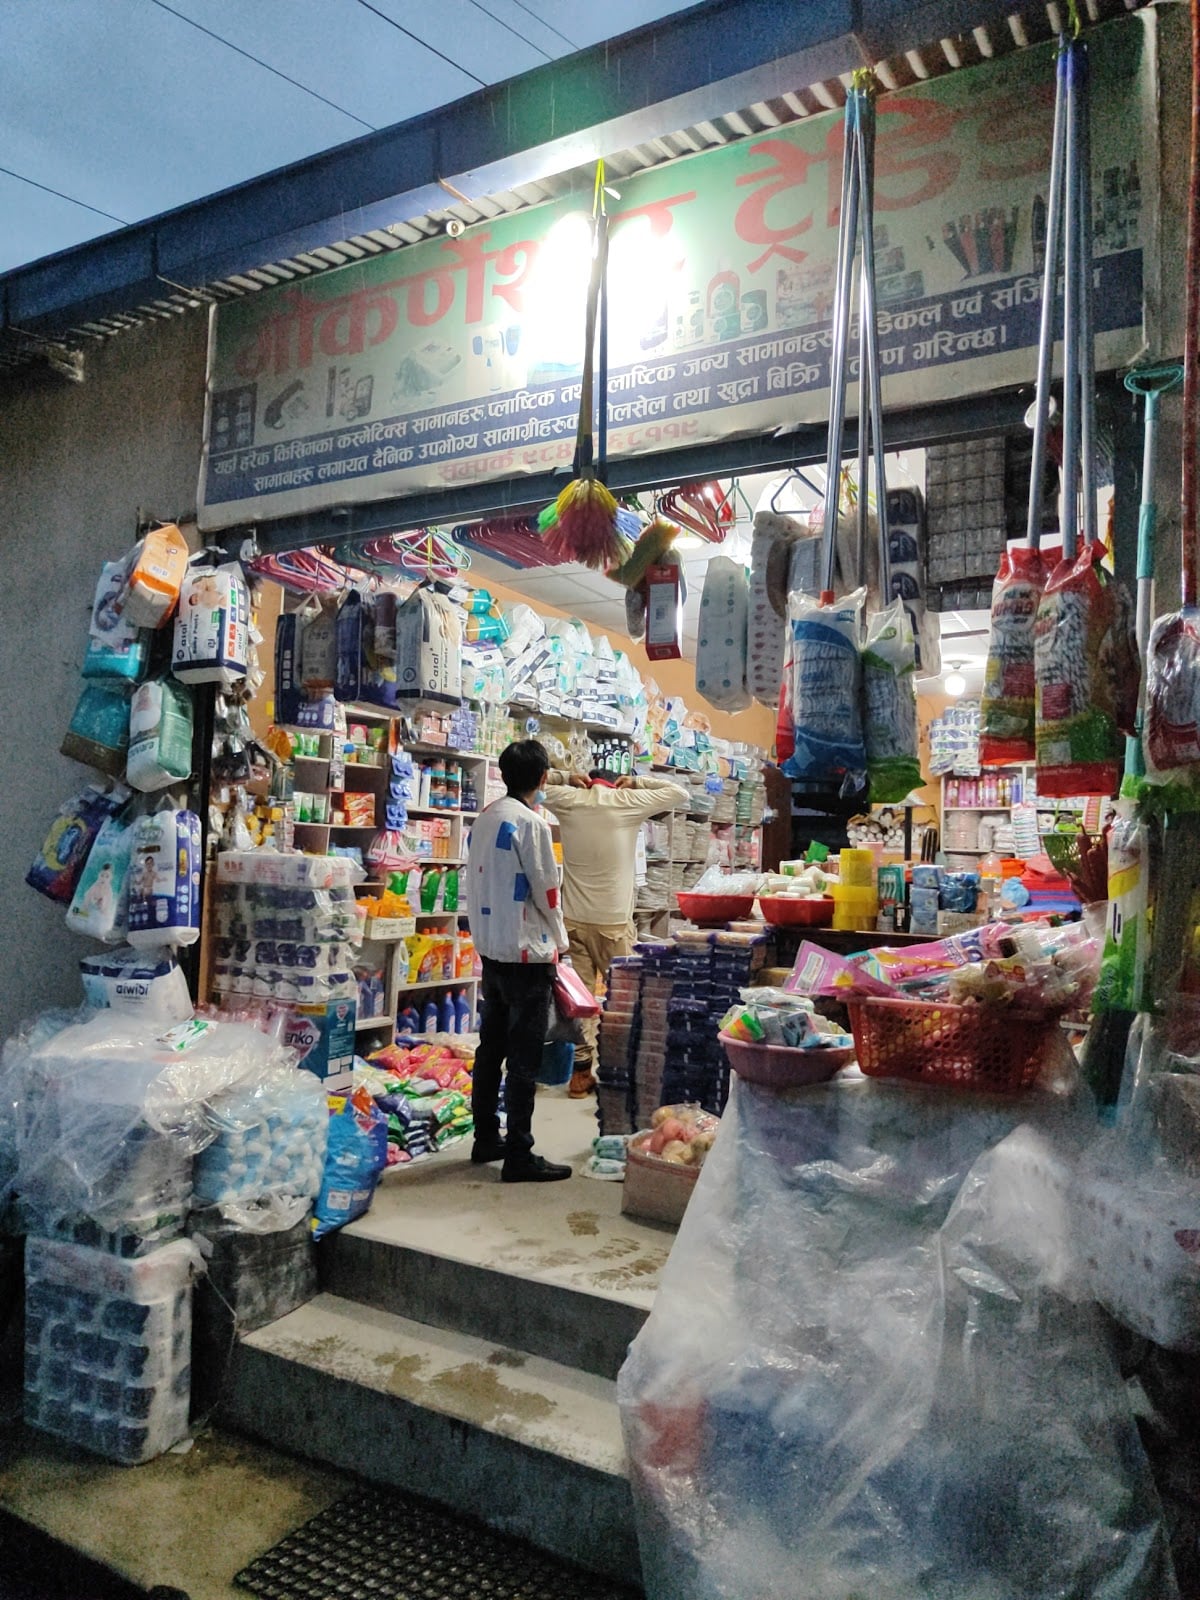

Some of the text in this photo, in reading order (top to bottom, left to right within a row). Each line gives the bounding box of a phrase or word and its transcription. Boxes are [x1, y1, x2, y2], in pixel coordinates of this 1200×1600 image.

[607, 363, 677, 394] लाष्टिक
[683, 350, 729, 377] जन्य
[317, 454, 370, 480] लगायत
[372, 444, 415, 470] दैनिक
[418, 433, 480, 460] उपभोग्य
[673, 386, 712, 410] तथा
[717, 375, 761, 404] खुद्रा
